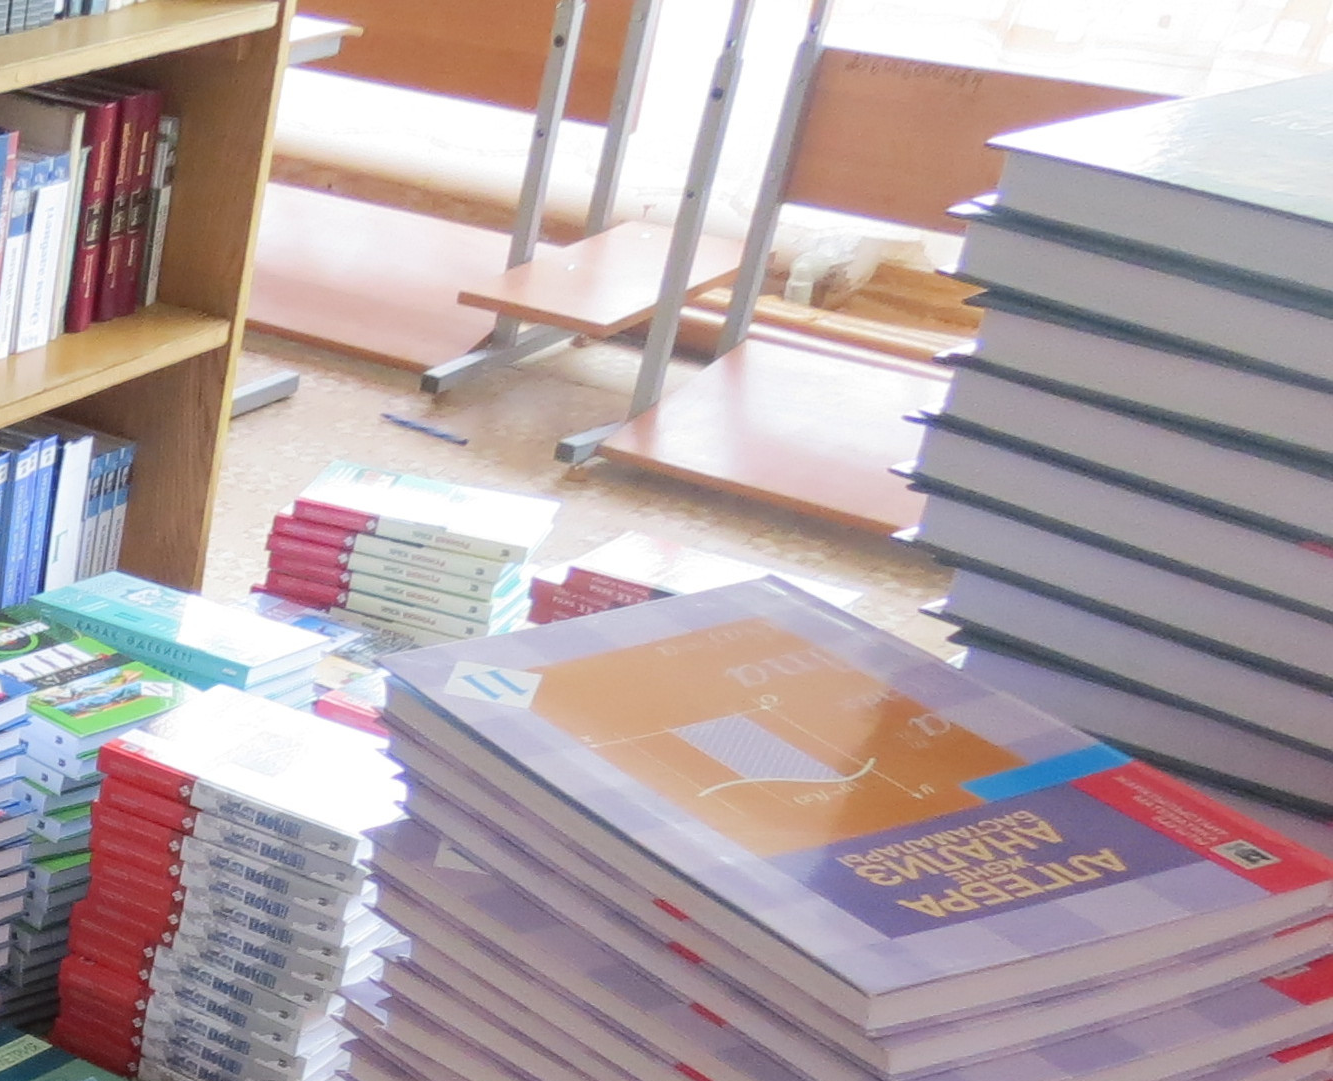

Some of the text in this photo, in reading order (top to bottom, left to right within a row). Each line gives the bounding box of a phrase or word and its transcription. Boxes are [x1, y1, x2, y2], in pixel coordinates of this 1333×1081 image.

[51, 530, 66, 564] Г
[462, 670, 528, 700] 11
[835, 809, 1041, 868] БАСТАМАЛАРЫ
[855, 820, 1063, 888] АНАЛИЗ
[896, 848, 1129, 918] АЛГЕБРА
[945, 857, 1035, 885] ЖӘНЕ
